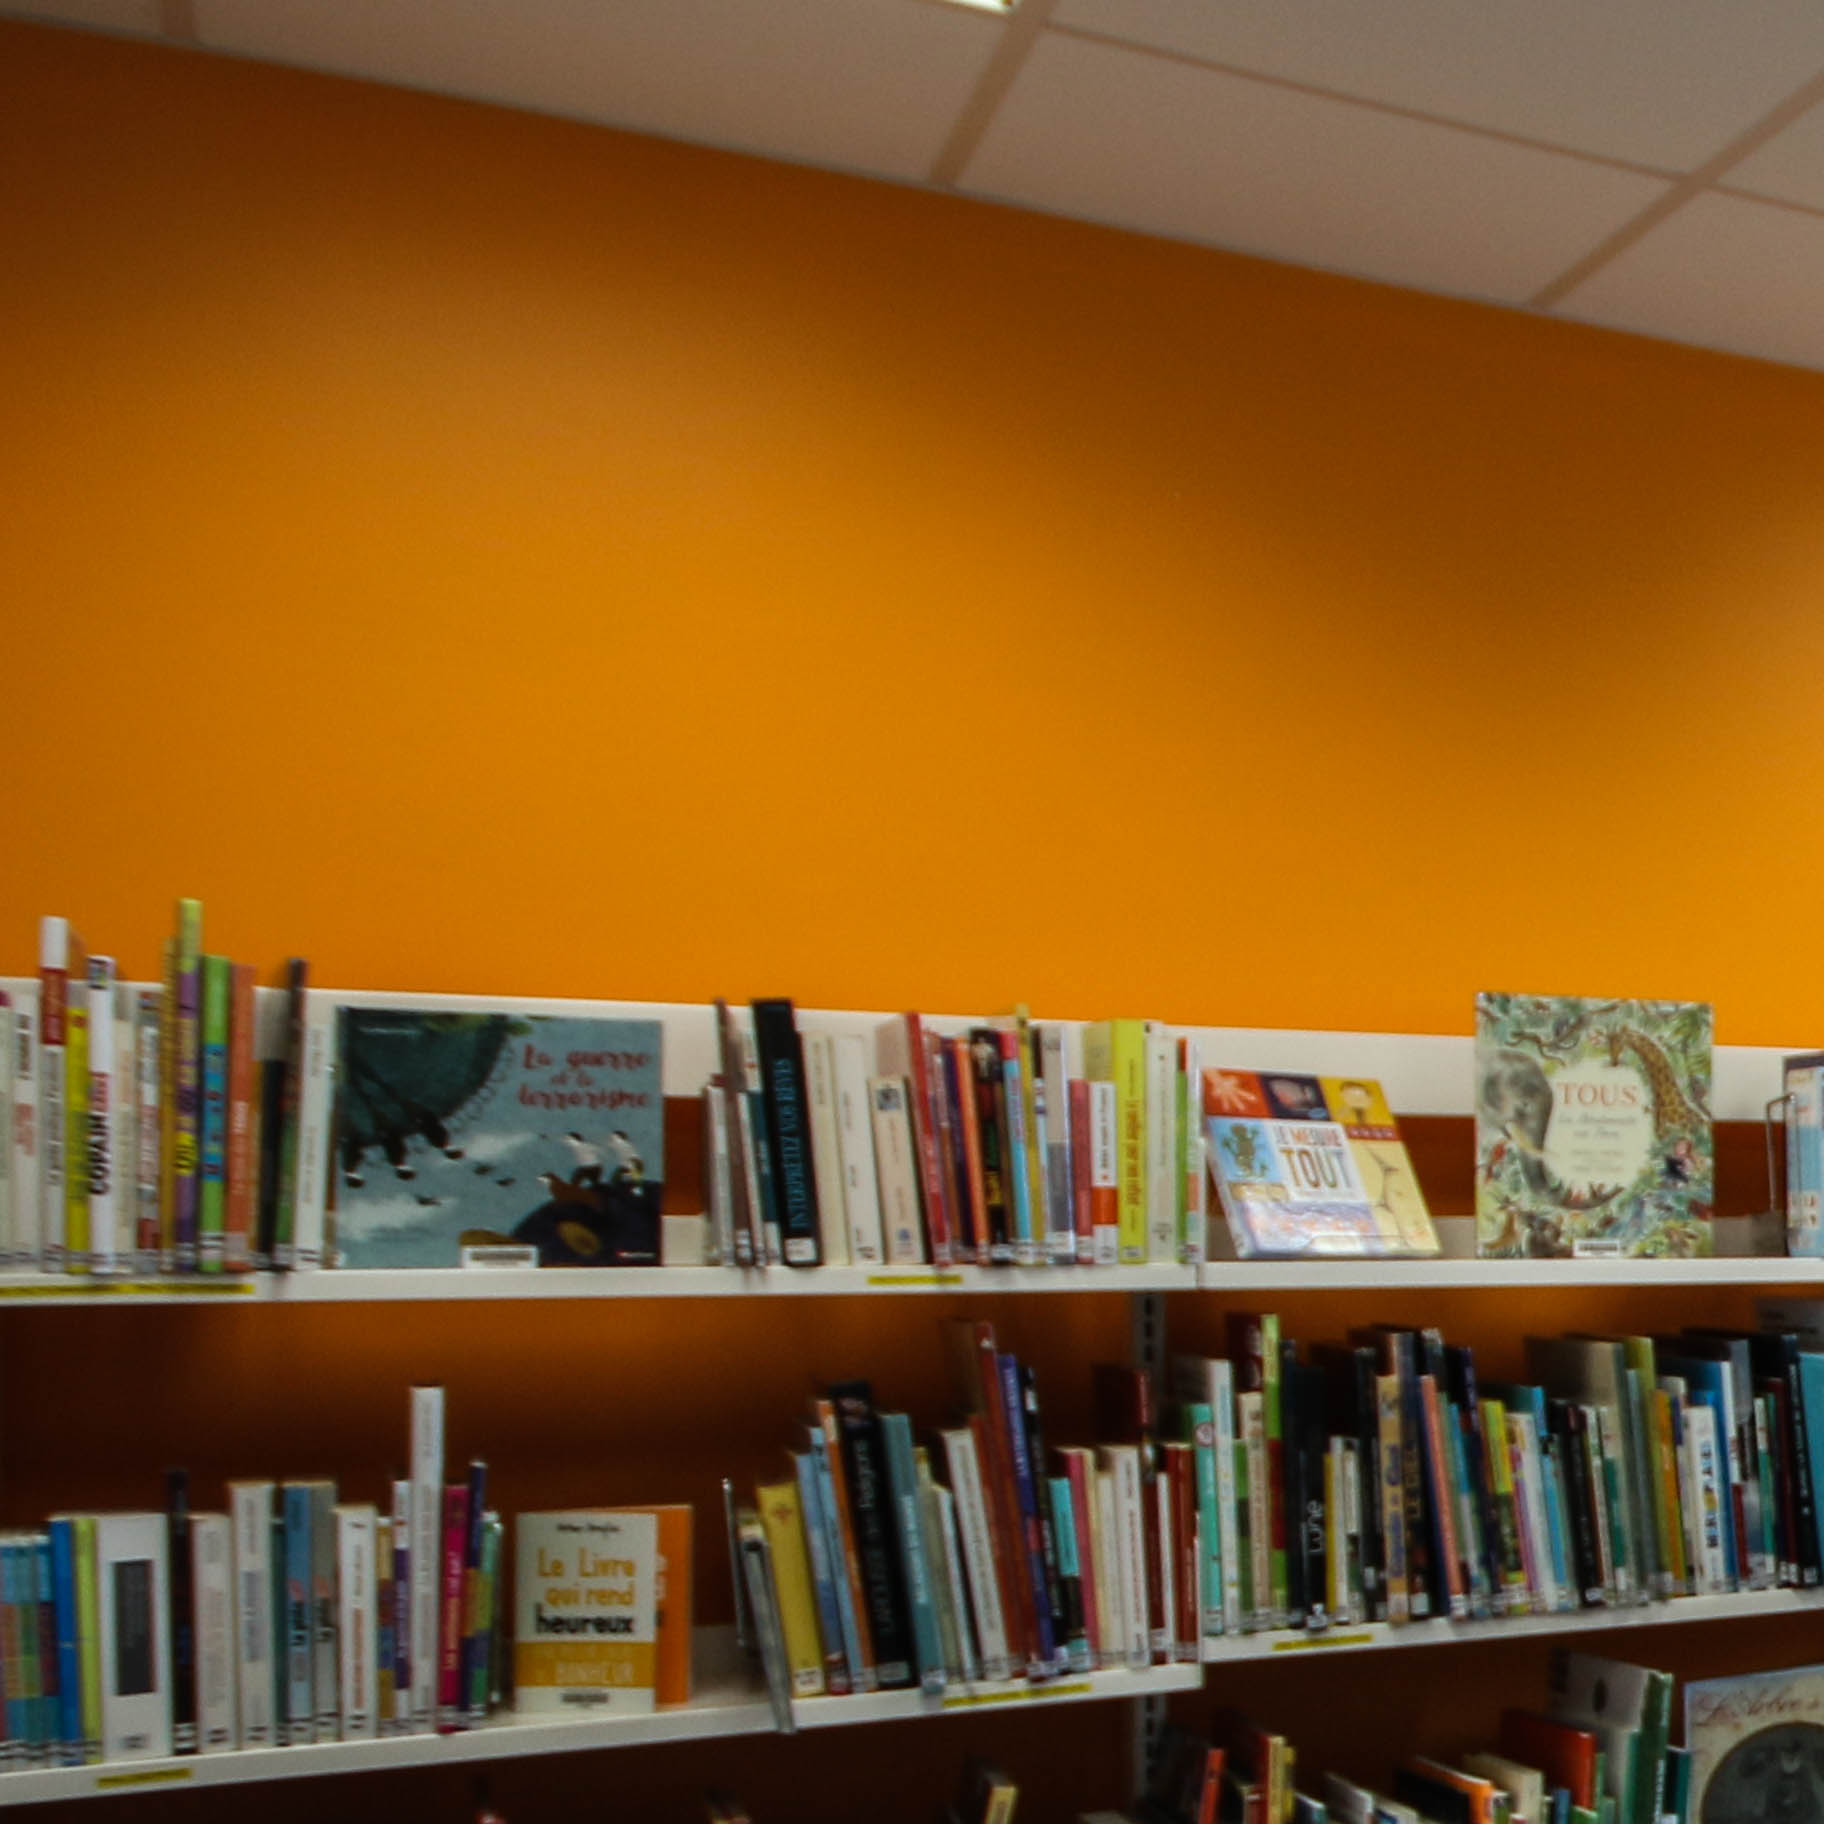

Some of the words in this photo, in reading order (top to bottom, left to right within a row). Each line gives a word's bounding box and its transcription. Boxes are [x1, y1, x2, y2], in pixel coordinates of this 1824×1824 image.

[1555, 1081, 1640, 1107] TOUS
[1280, 1148, 1352, 1190] TOUT
[537, 1548, 564, 1578] Le
[578, 1548, 635, 1578] Livre
[544, 1583, 580, 1609] qui
[584, 1583, 635, 1608] rend
[533, 1602, 636, 1635] heureux
